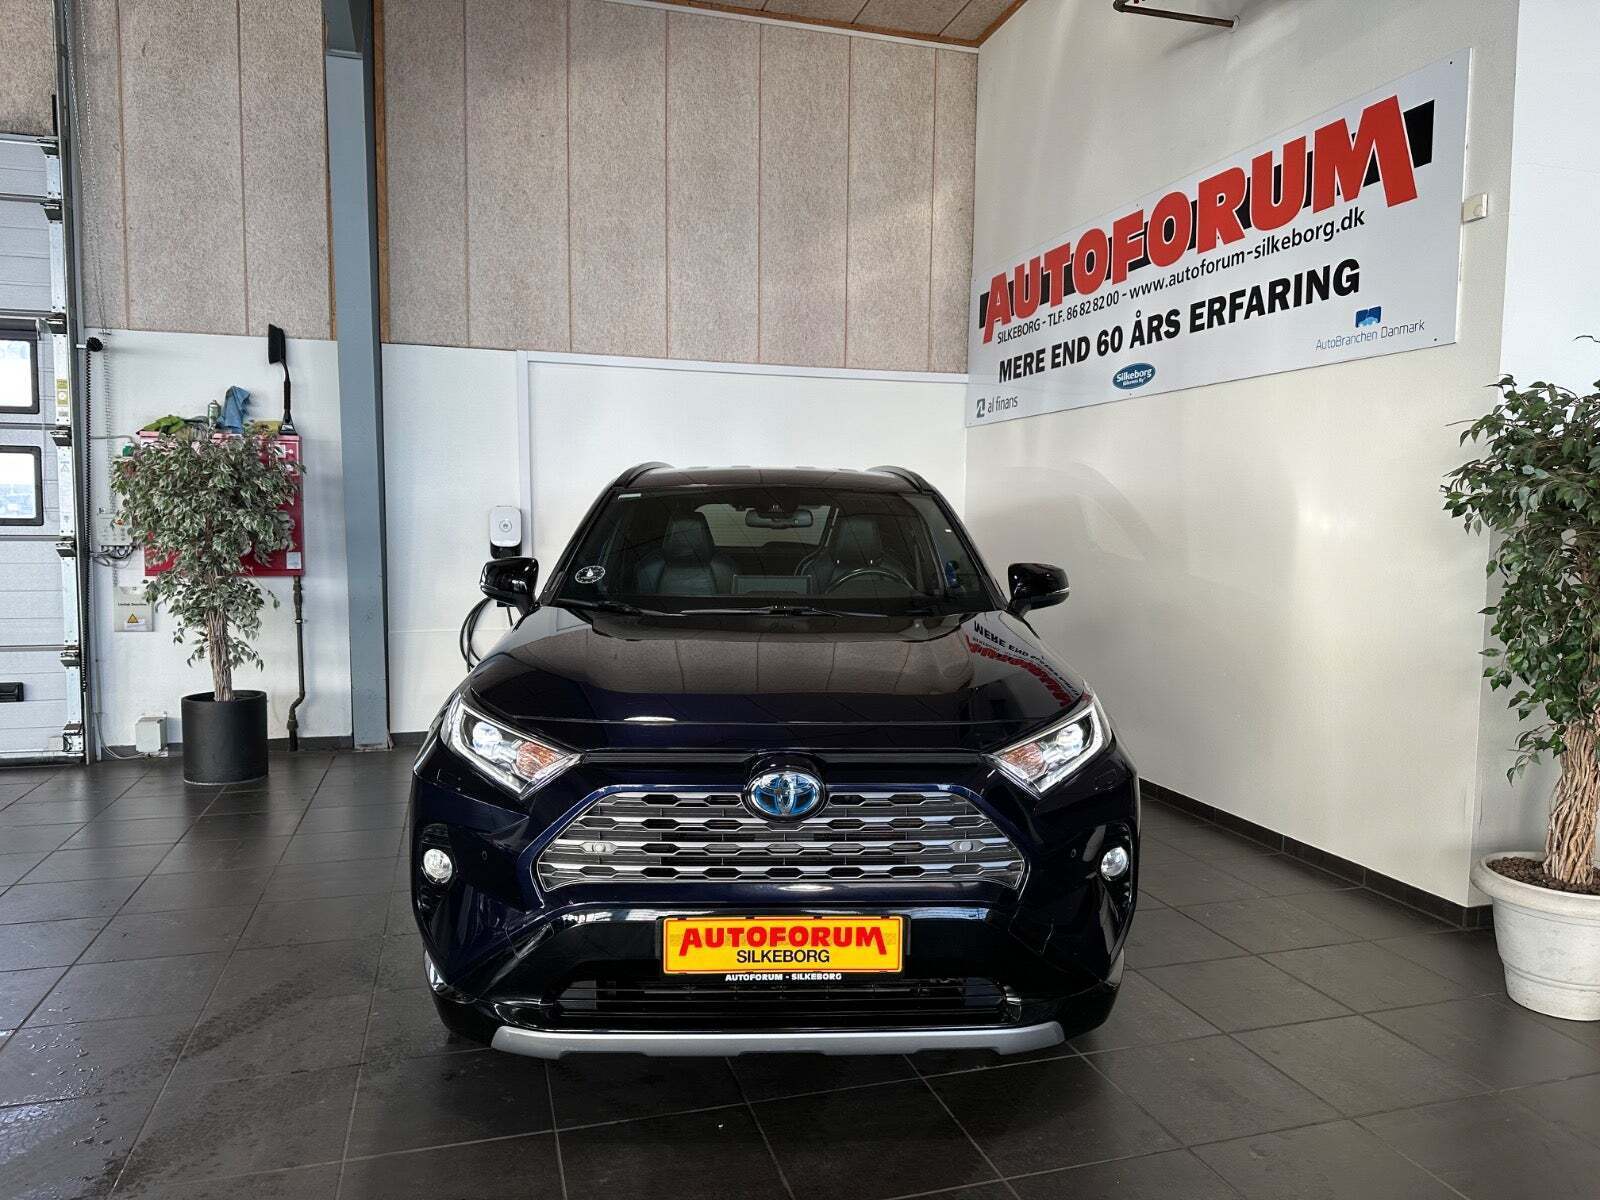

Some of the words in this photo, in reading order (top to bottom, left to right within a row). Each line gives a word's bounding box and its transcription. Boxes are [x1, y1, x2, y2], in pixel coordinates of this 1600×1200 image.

[983, 95, 1418, 344] AUTOFORUM
[997, 318, 1041, 344] SILKEBORG
[1048, 310, 1065, 327] TLF.
[1129, 206, 1366, 300] www.autoforum-silkeborg.dk
[999, 348, 1046, 384] MERE
[1050, 335, 1091, 370] END
[1097, 325, 1124, 357] 60
[1130, 308, 1181, 350] ÅRS
[1189, 258, 1361, 334] ERFARING
[1315, 331, 1378, 351] AutoBranchen
[1381, 319, 1425, 339] Danmark
[1116, 368, 1153, 382] Silkeborg
[995, 395, 1018, 412] finans
[678, 925, 887, 957] AUTOFORUM
[736, 949, 830, 964] SILKEBORG
[725, 973, 783, 981] AUTOFORUM
[791, 973, 842, 981] SILKEBORG
